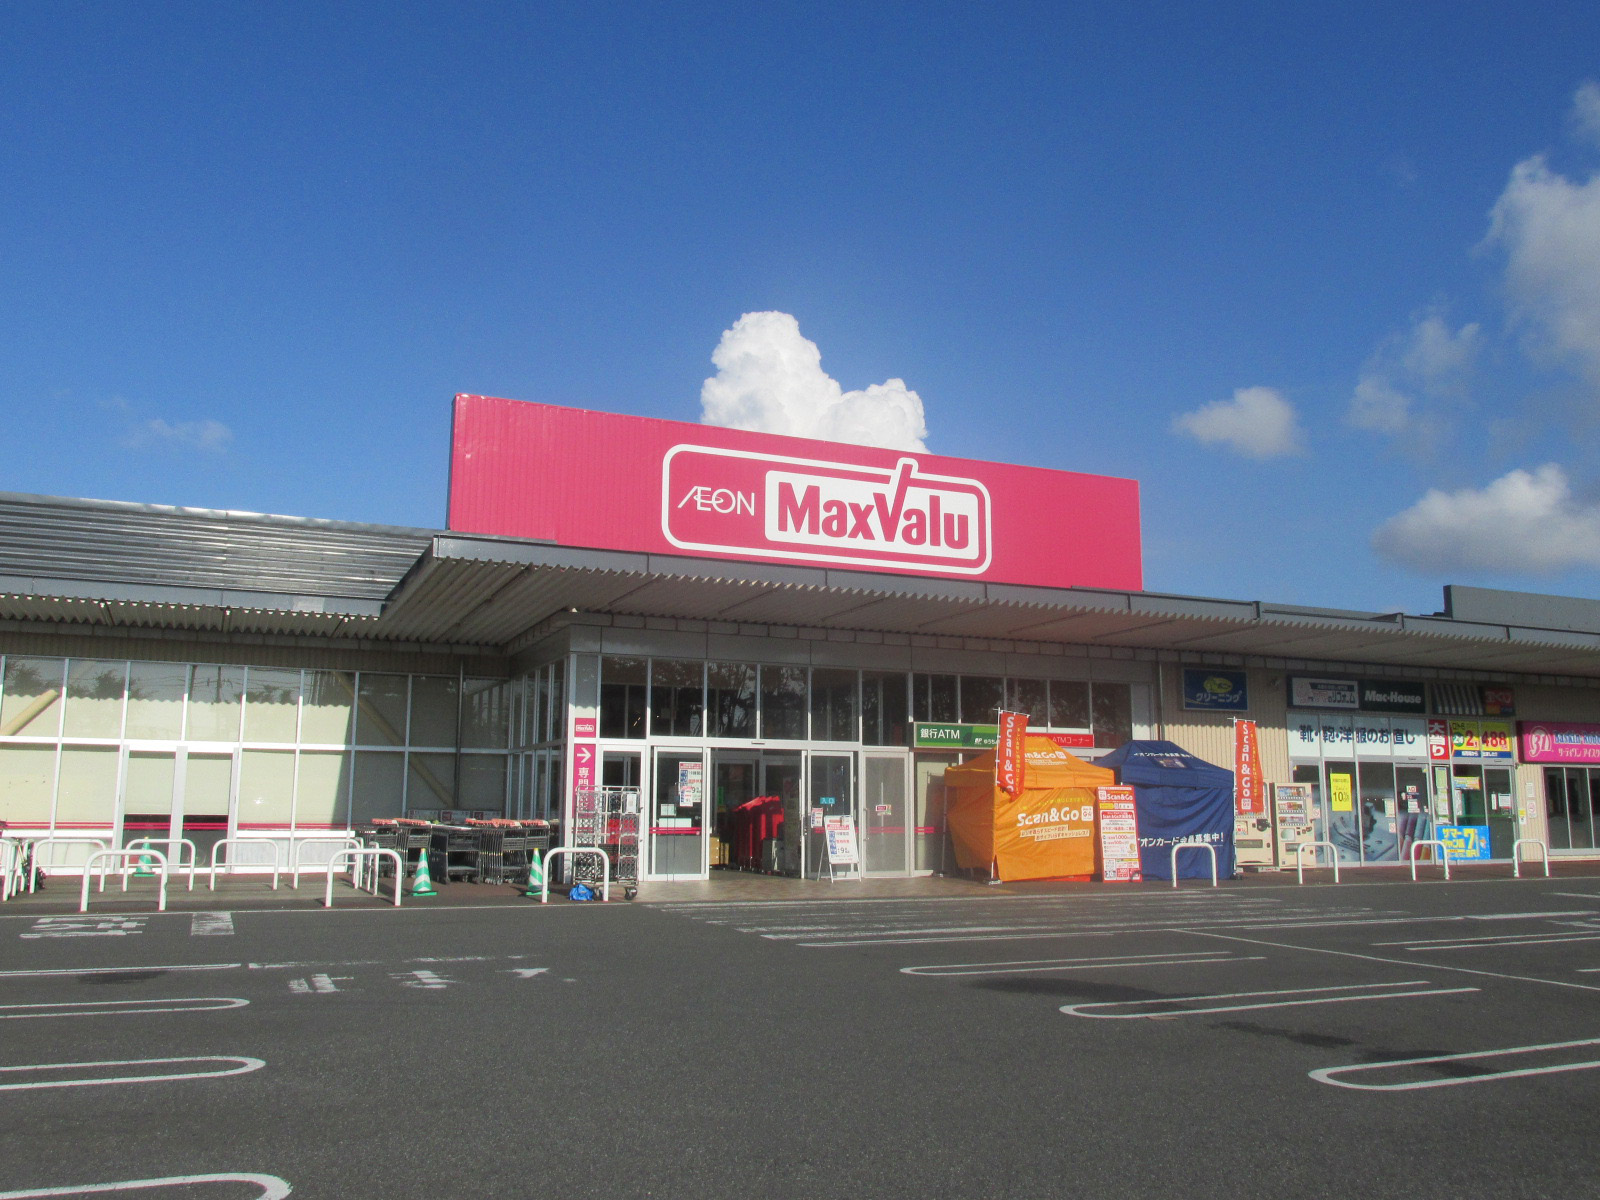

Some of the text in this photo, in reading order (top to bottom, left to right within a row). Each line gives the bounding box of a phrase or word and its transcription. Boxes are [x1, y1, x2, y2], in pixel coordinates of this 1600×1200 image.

[777, 463, 969, 549] MaxValu
[920, 728, 960, 740] 銀行ATM
[1052, 736, 1090, 744] ATMコーナー
[1241, 724, 1251, 797] Scan&Go
[1016, 807, 1080, 827] Scan&Go
[1138, 832, 1224, 847] オンカード会員募集中!
